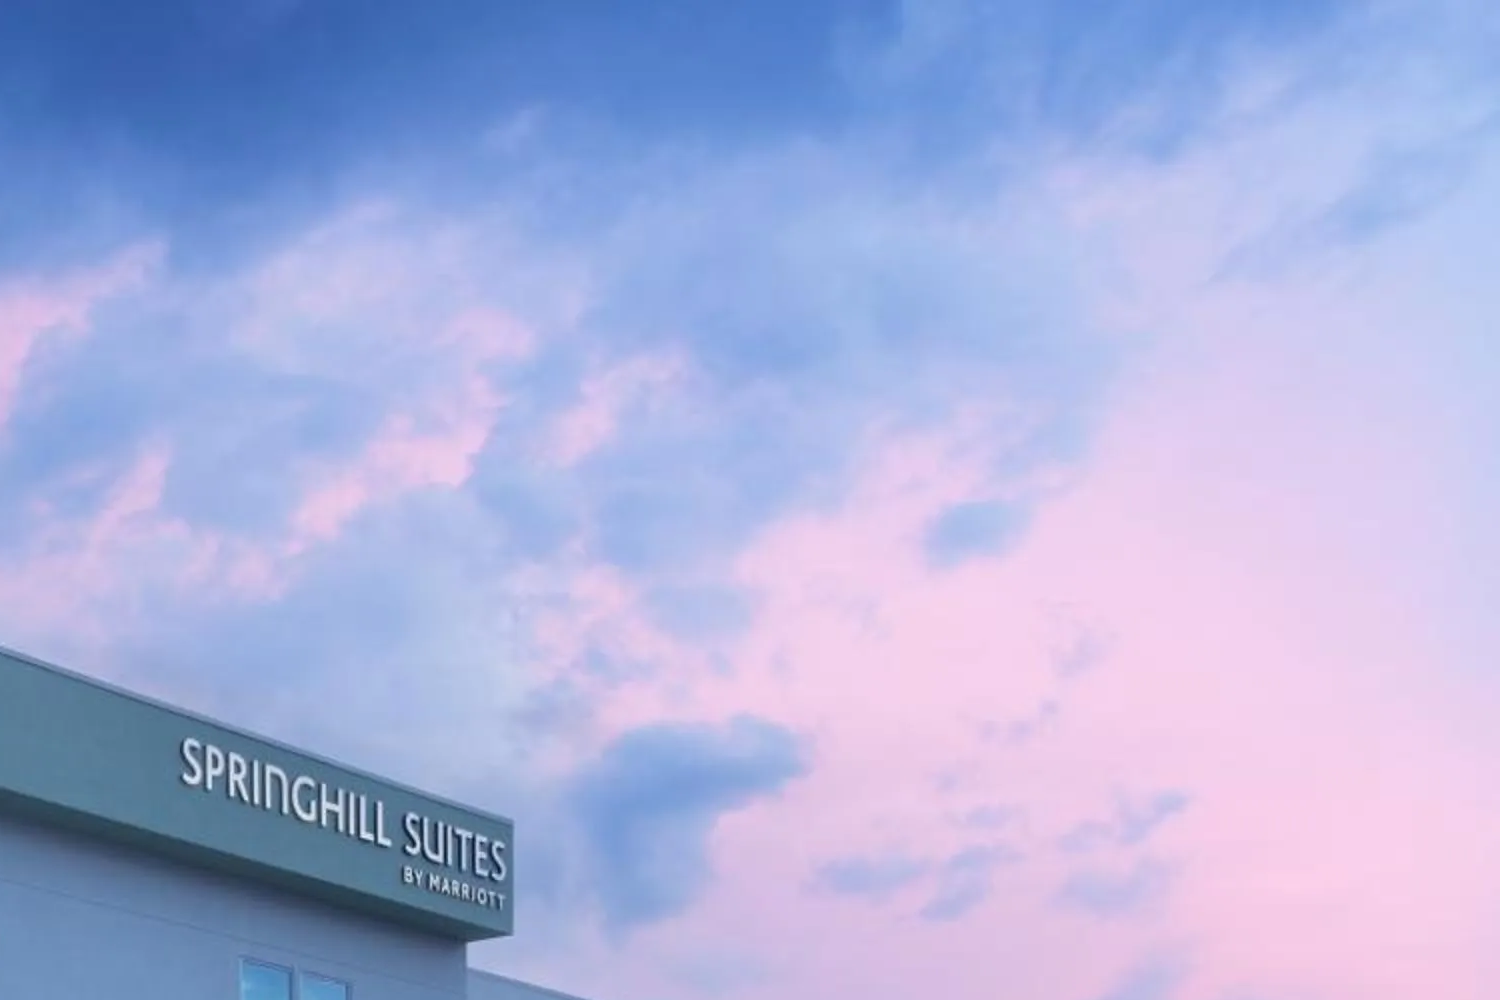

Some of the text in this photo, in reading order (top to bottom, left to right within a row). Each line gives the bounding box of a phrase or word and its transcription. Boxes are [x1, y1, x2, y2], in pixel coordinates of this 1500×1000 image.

[181, 737, 507, 881] SPRINGHILL SUITES
[403, 866, 507, 911] BY MARRIOTT
